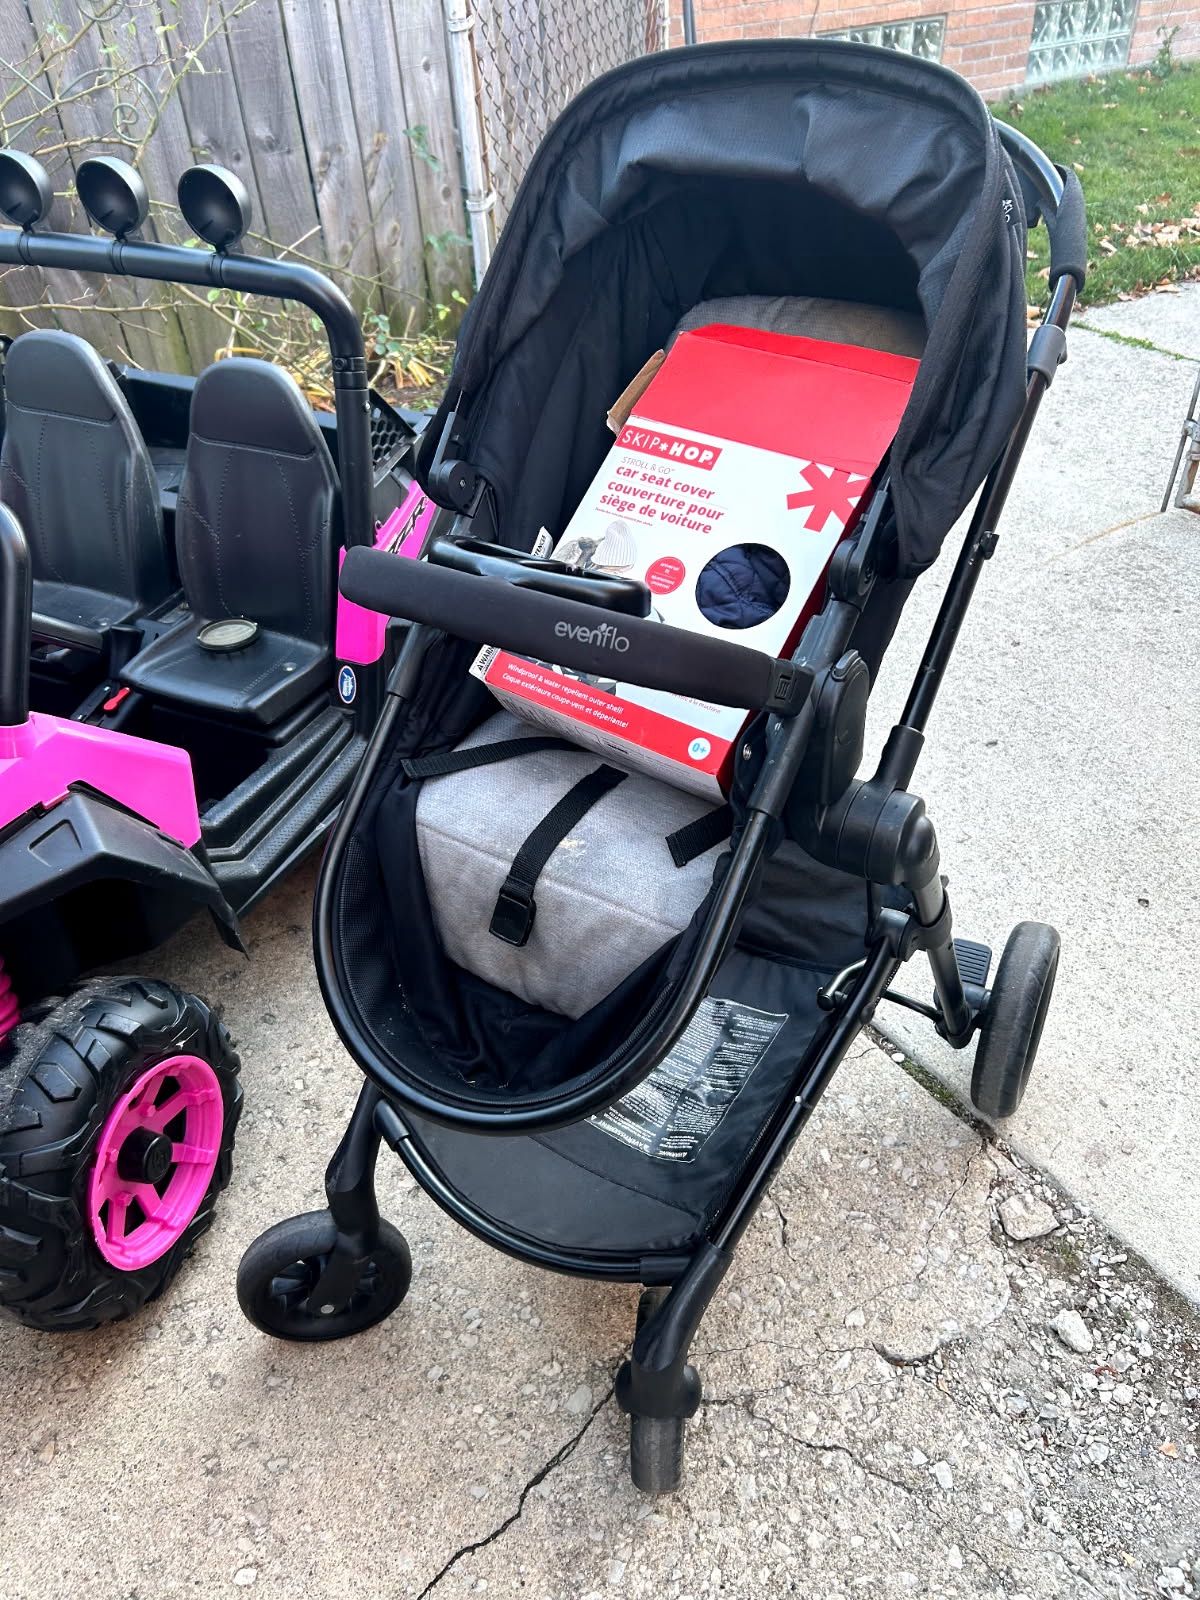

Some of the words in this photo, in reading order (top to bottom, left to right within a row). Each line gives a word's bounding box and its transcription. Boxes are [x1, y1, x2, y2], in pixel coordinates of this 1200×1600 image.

[622, 430, 661, 449] SKIP
[621, 456, 649, 470] STROLL
[650, 463, 657, 471] &
[616, 465, 640, 479] car
[640, 471, 672, 488] seat
[673, 481, 716, 500] cover
[599, 494, 636, 513] siège
[638, 504, 657, 518] de
[660, 511, 712, 534] voiture
[607, 481, 686, 510] couverture
[686, 503, 725, 521] pour
[554, 621, 630, 652] evenflo
[502, 672, 522, 685] Coque
[521, 681, 552, 697] extérieure
[551, 693, 585, 711] coupe-vent
[507, 663, 540, 680] Windproof
[537, 675, 544, 683] &
[543, 678, 562, 689] water
[561, 685, 589, 701] repellent
[588, 696, 606, 707] outer
[691, 742, 707, 753] 0+
